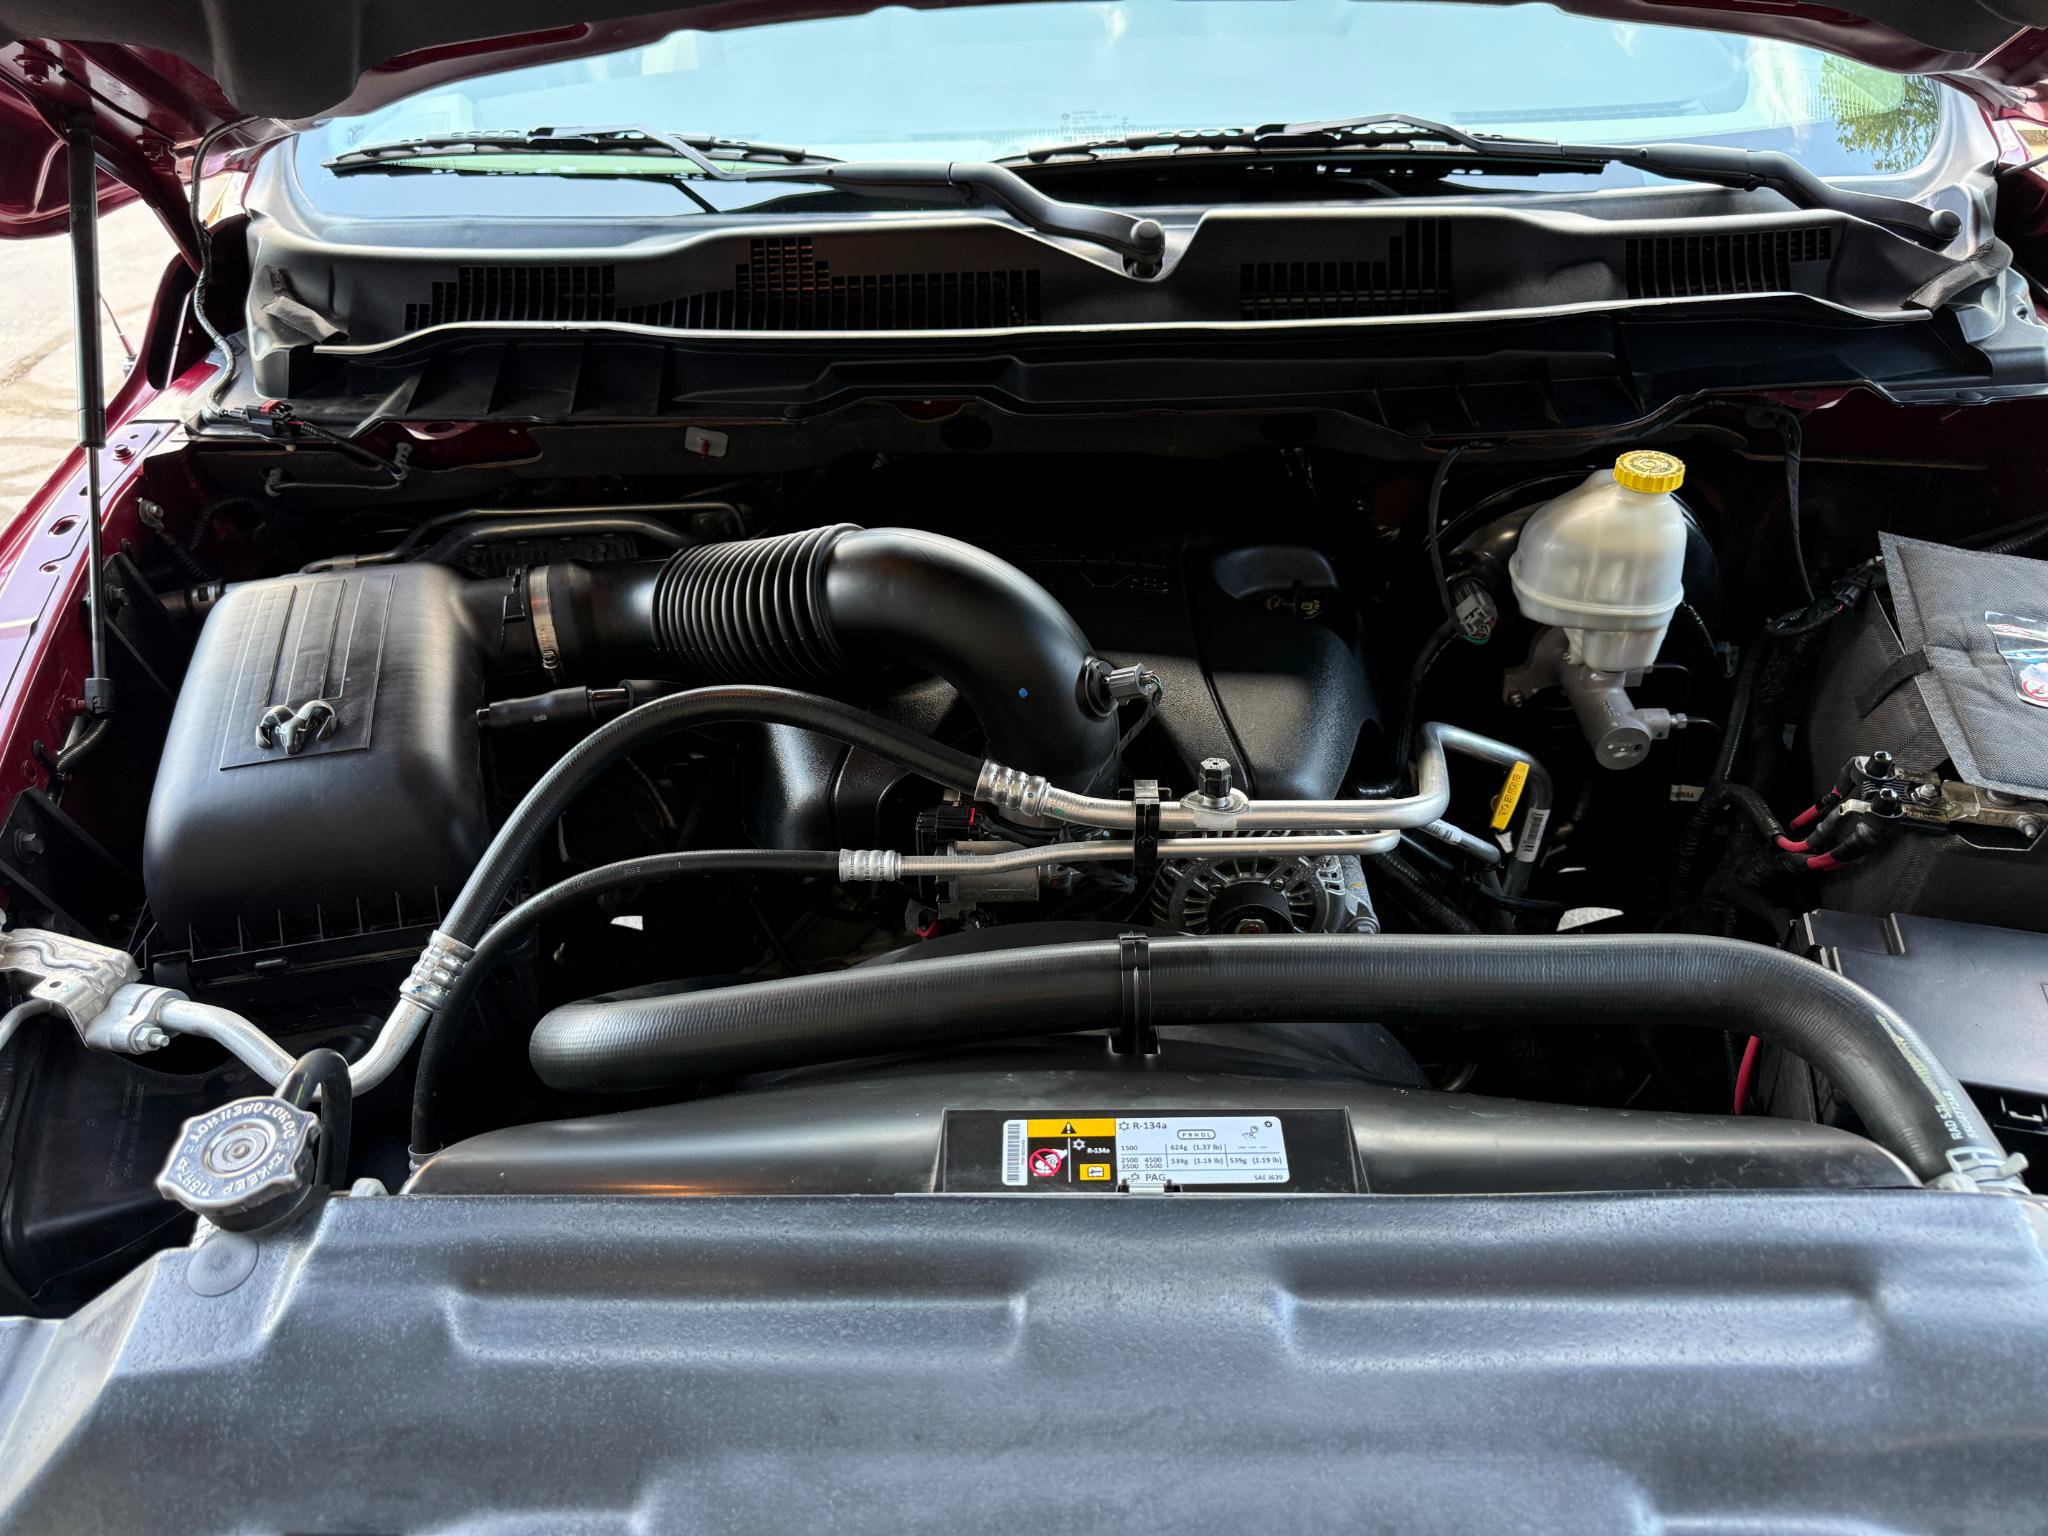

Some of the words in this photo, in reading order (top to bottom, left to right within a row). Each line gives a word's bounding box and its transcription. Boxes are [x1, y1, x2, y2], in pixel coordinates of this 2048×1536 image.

[220, 1102, 263, 1121] OPEN
[264, 1103, 292, 1124] NOT
[189, 1115, 219, 1142] HOT
[1133, 1122, 1167, 1130] R-134a
[1943, 1119, 1963, 1140] RAD
[1212, 1143, 1222, 1151] lb)
[1213, 1157, 1224, 1165] lb)
[176, 1169, 214, 1197] TIGHT
[223, 1166, 271, 1195] KEEP
[1145, 1173, 1166, 1181] PAG
